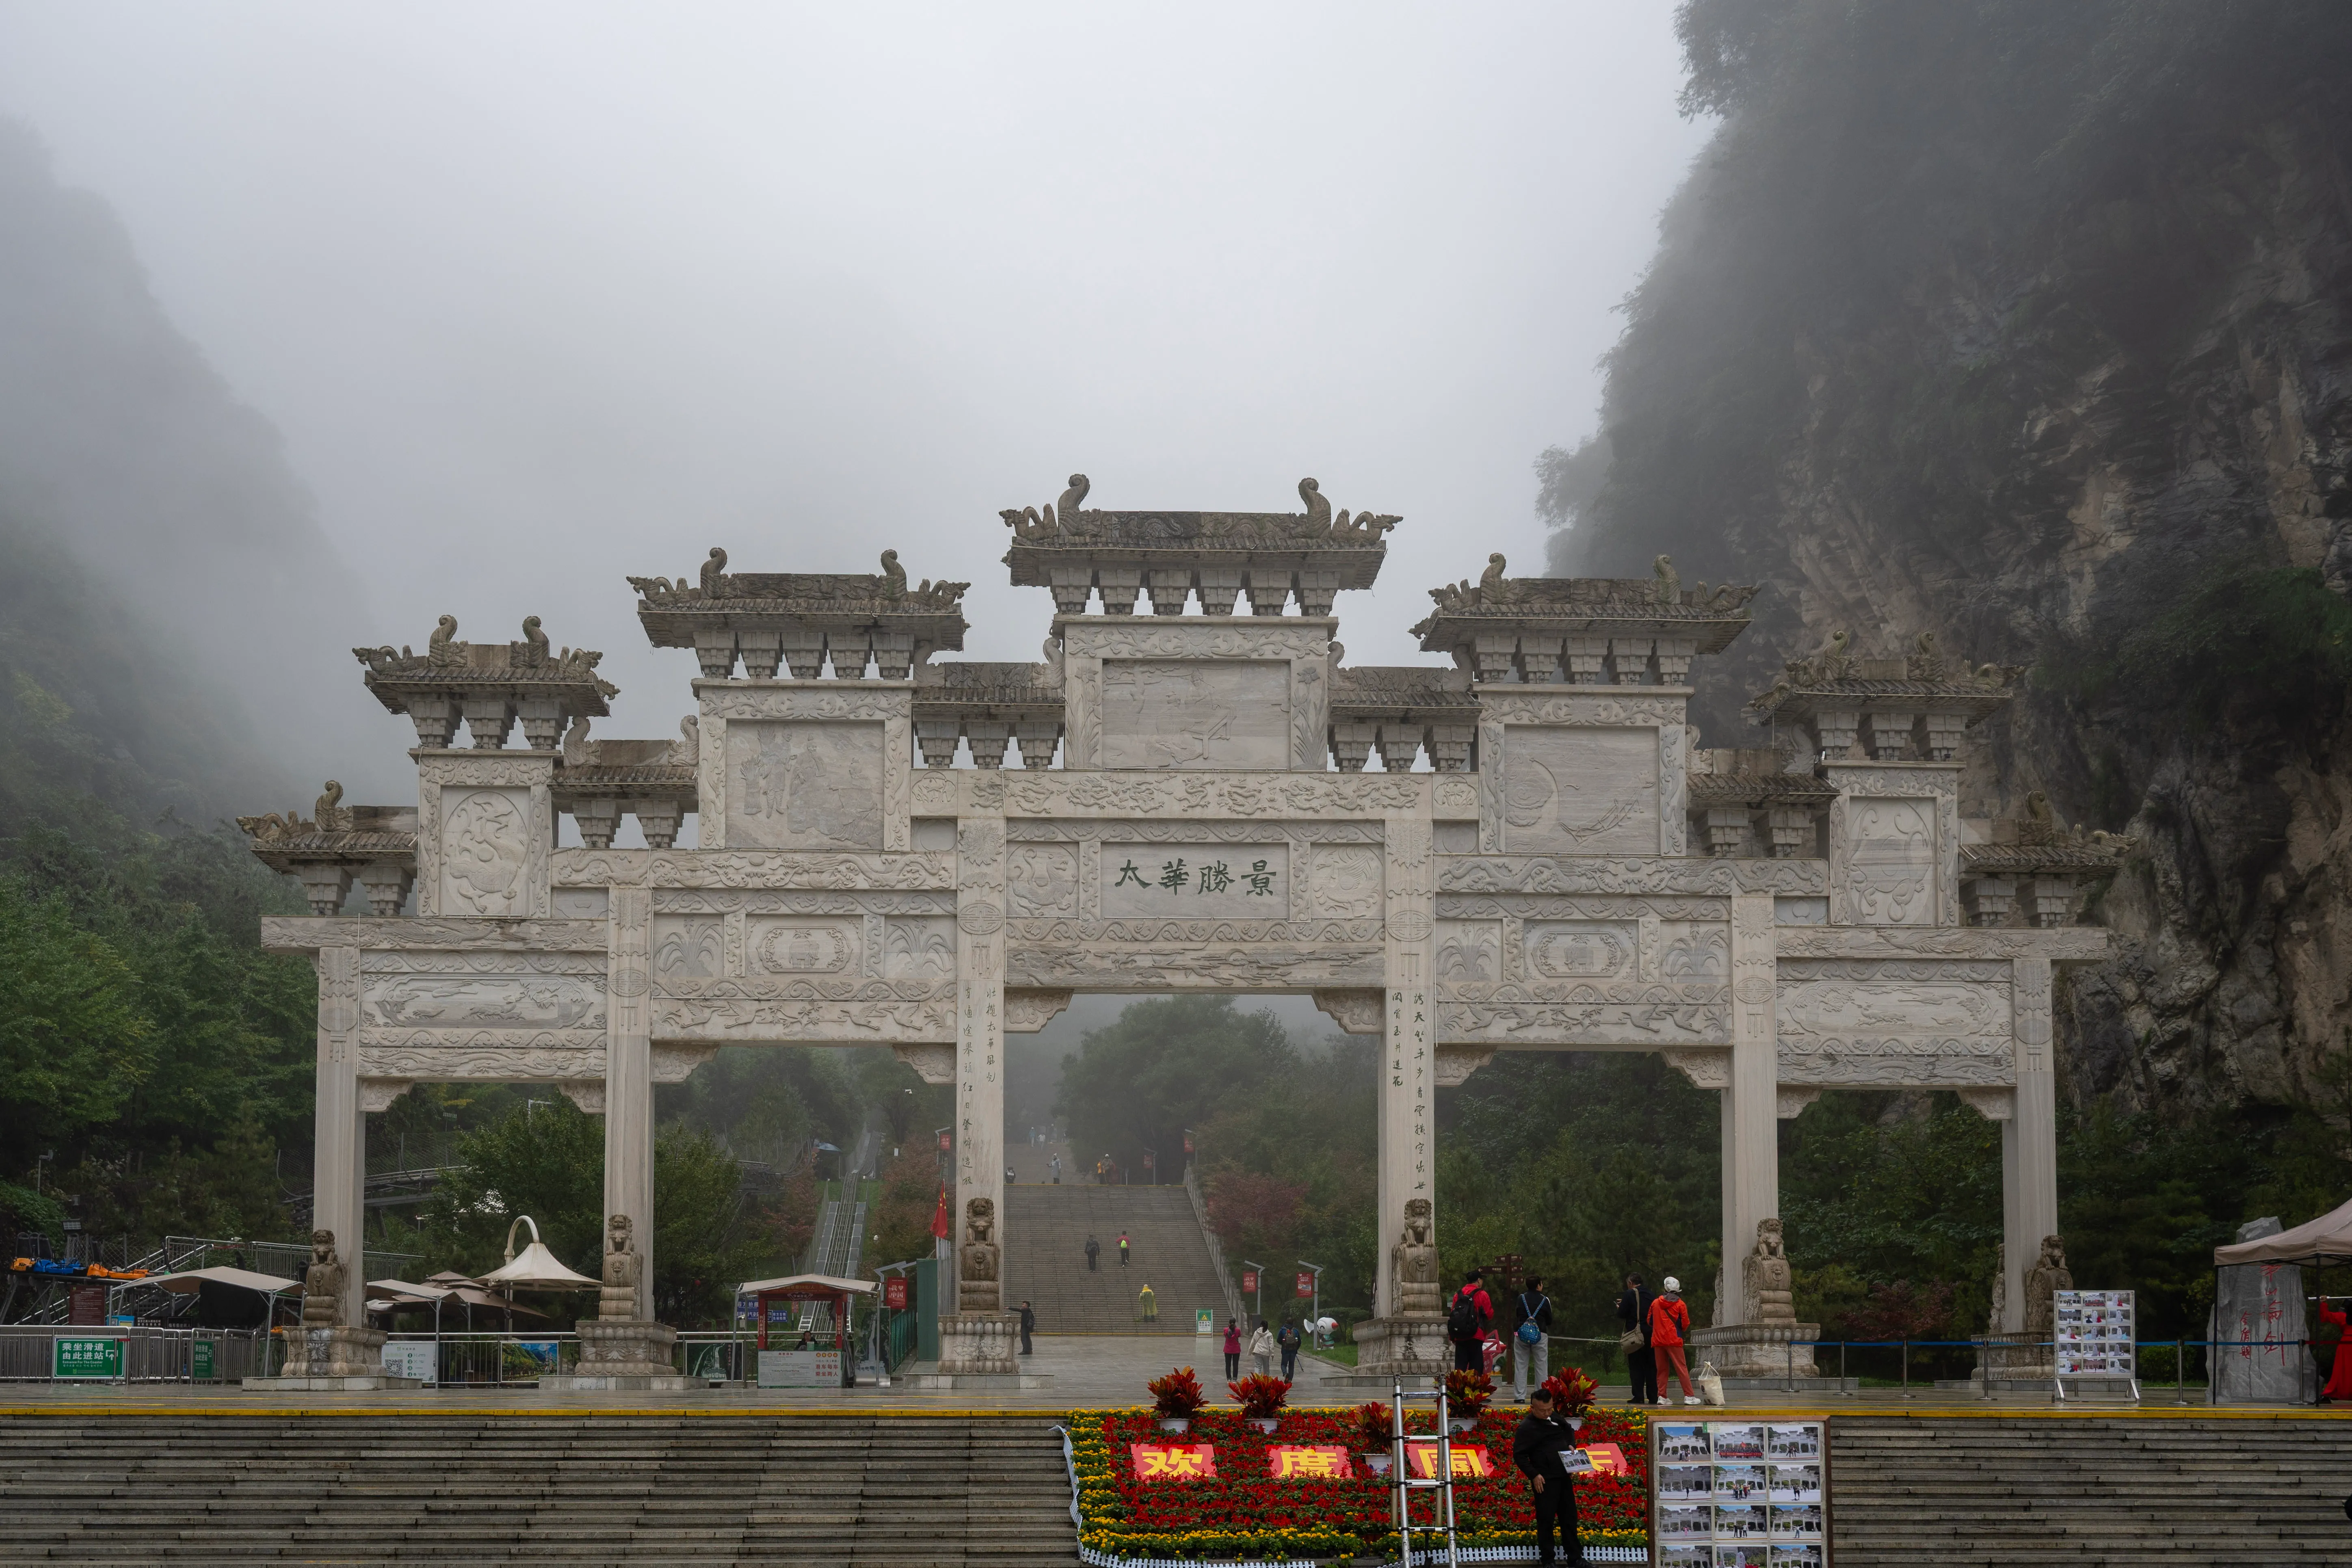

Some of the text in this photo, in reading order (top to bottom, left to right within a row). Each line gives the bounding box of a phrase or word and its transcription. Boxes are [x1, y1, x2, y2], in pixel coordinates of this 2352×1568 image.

[1114, 858, 1277, 897] 太華勝景
[62, 1343, 104, 1351] 乘坐滑道
[62, 1352, 103, 1360] 由此进站
